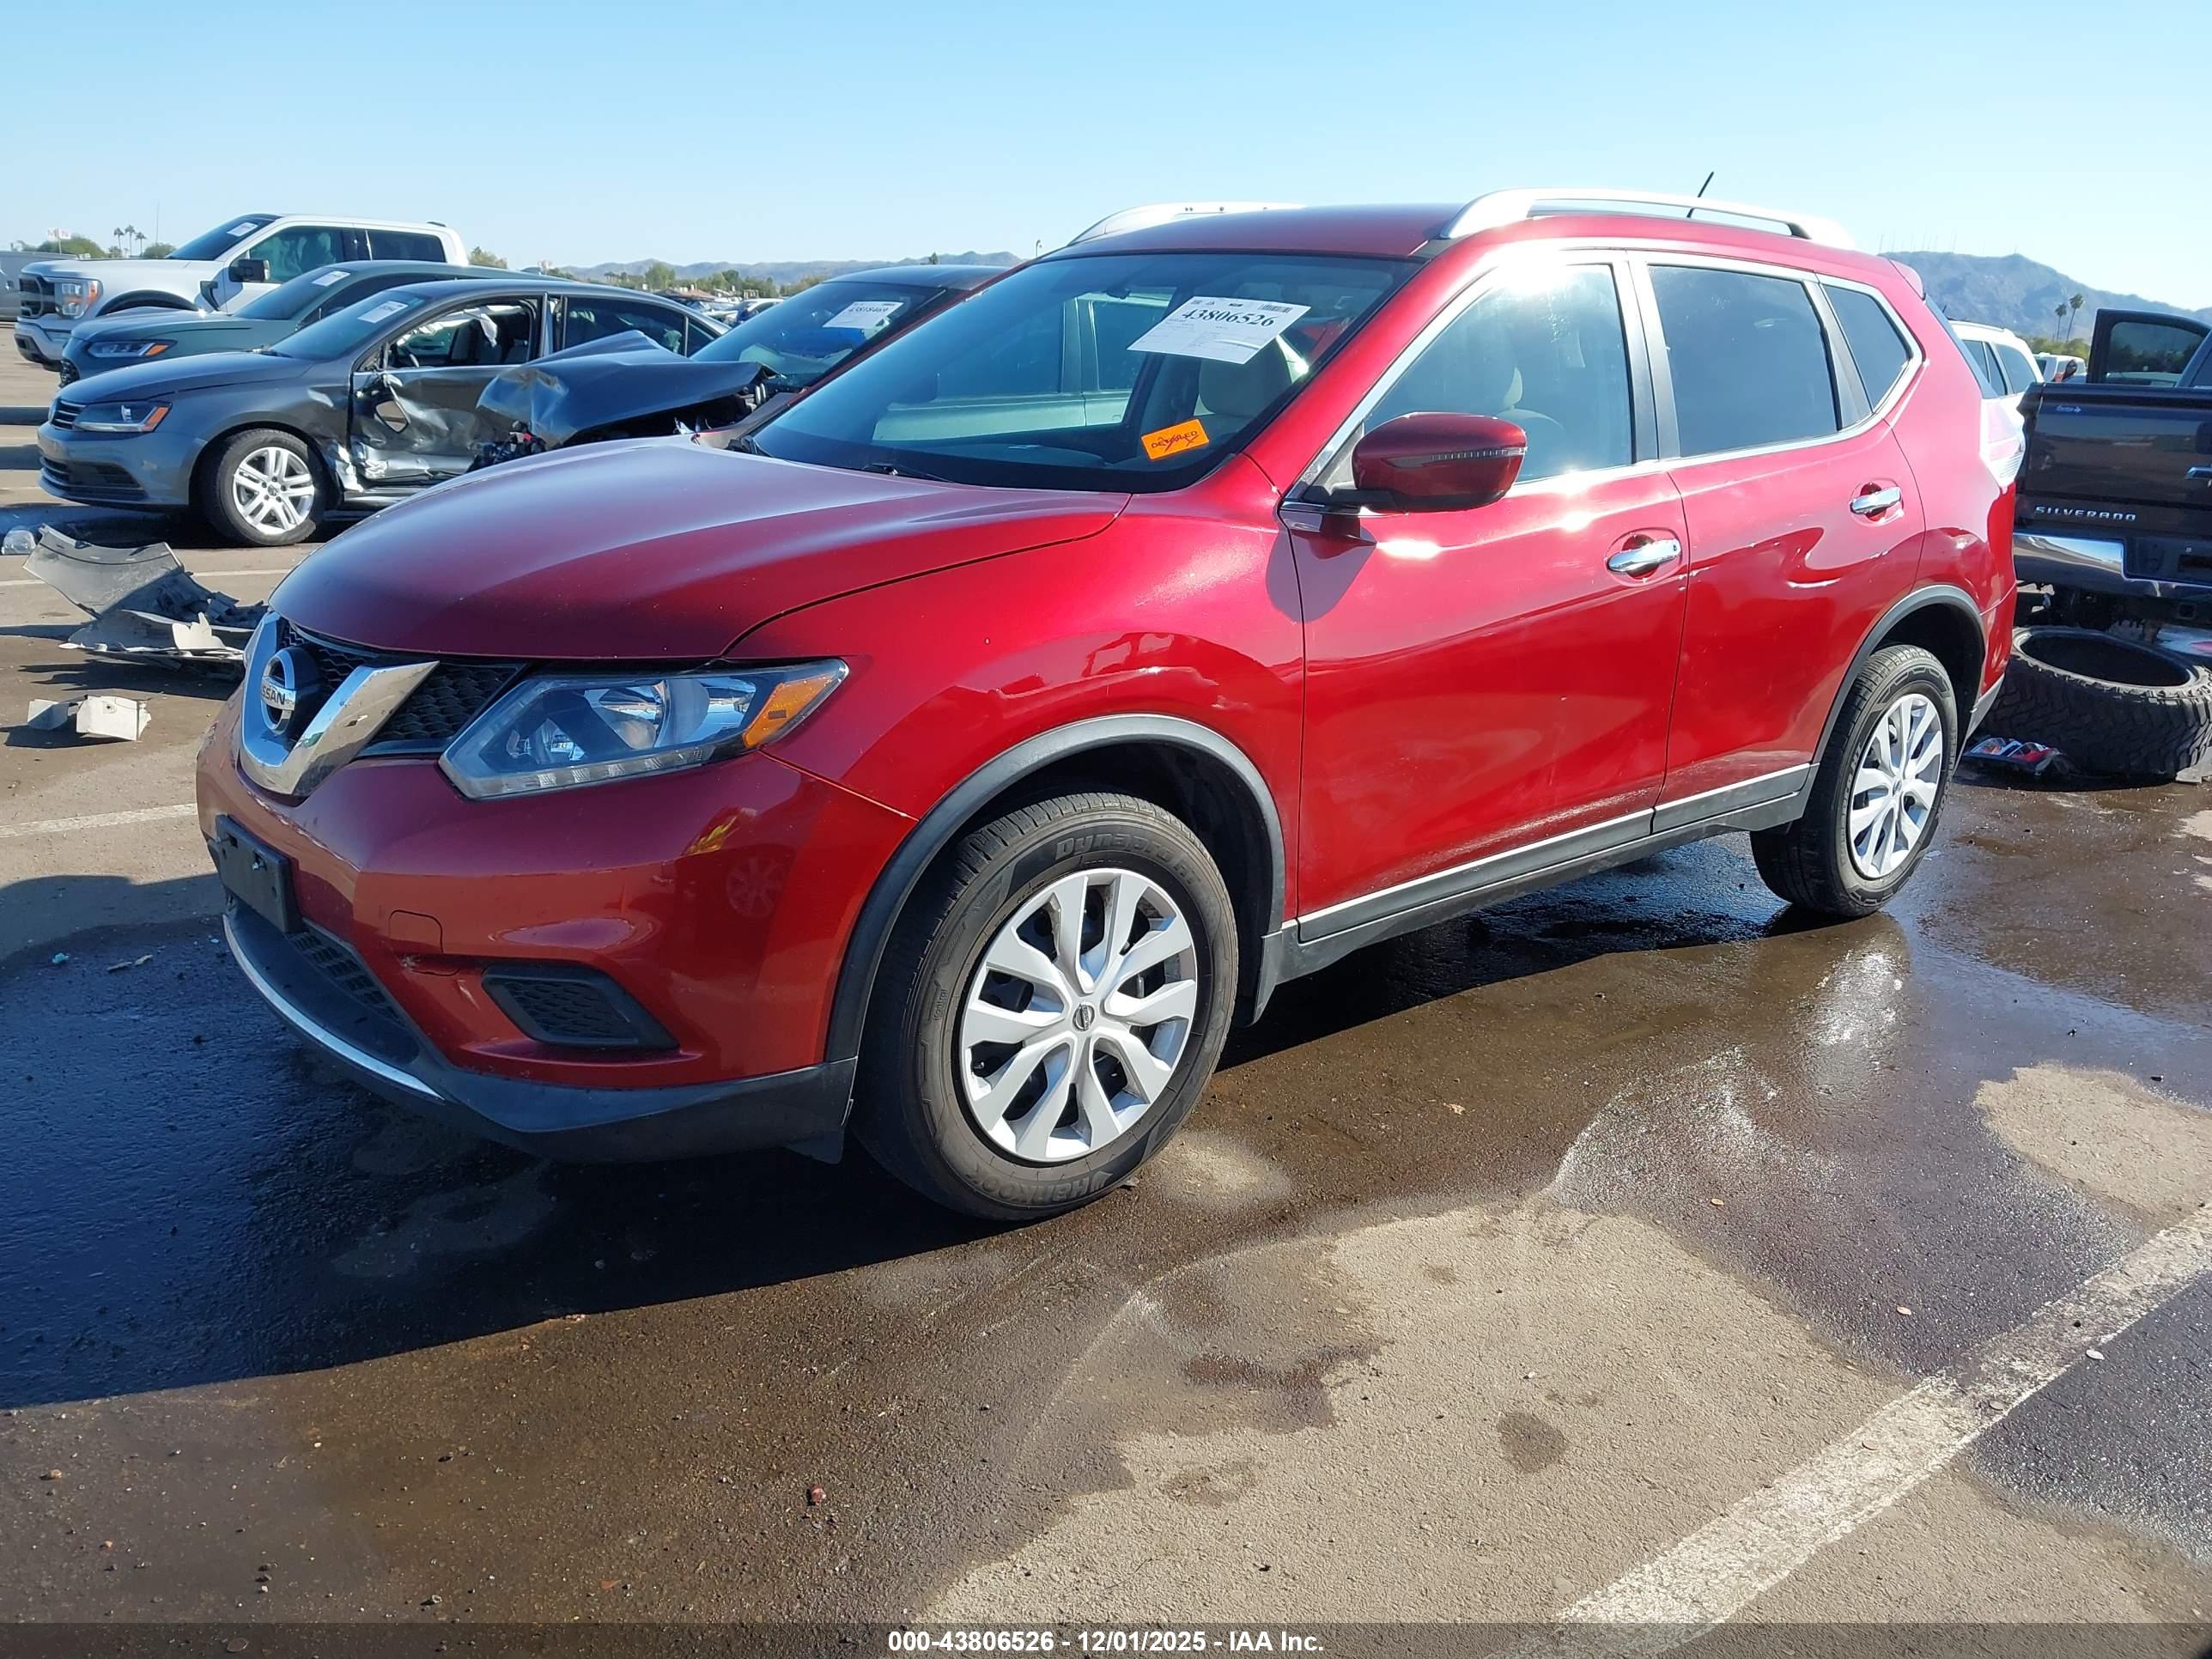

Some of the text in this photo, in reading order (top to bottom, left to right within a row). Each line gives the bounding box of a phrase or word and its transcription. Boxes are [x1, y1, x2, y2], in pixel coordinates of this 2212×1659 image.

[1182, 308, 1279, 327] 43806526
[2035, 506, 2136, 521] SILVERADO
[262, 686, 286, 705] SSAN
[1054, 833, 1174, 864] Dynapro
